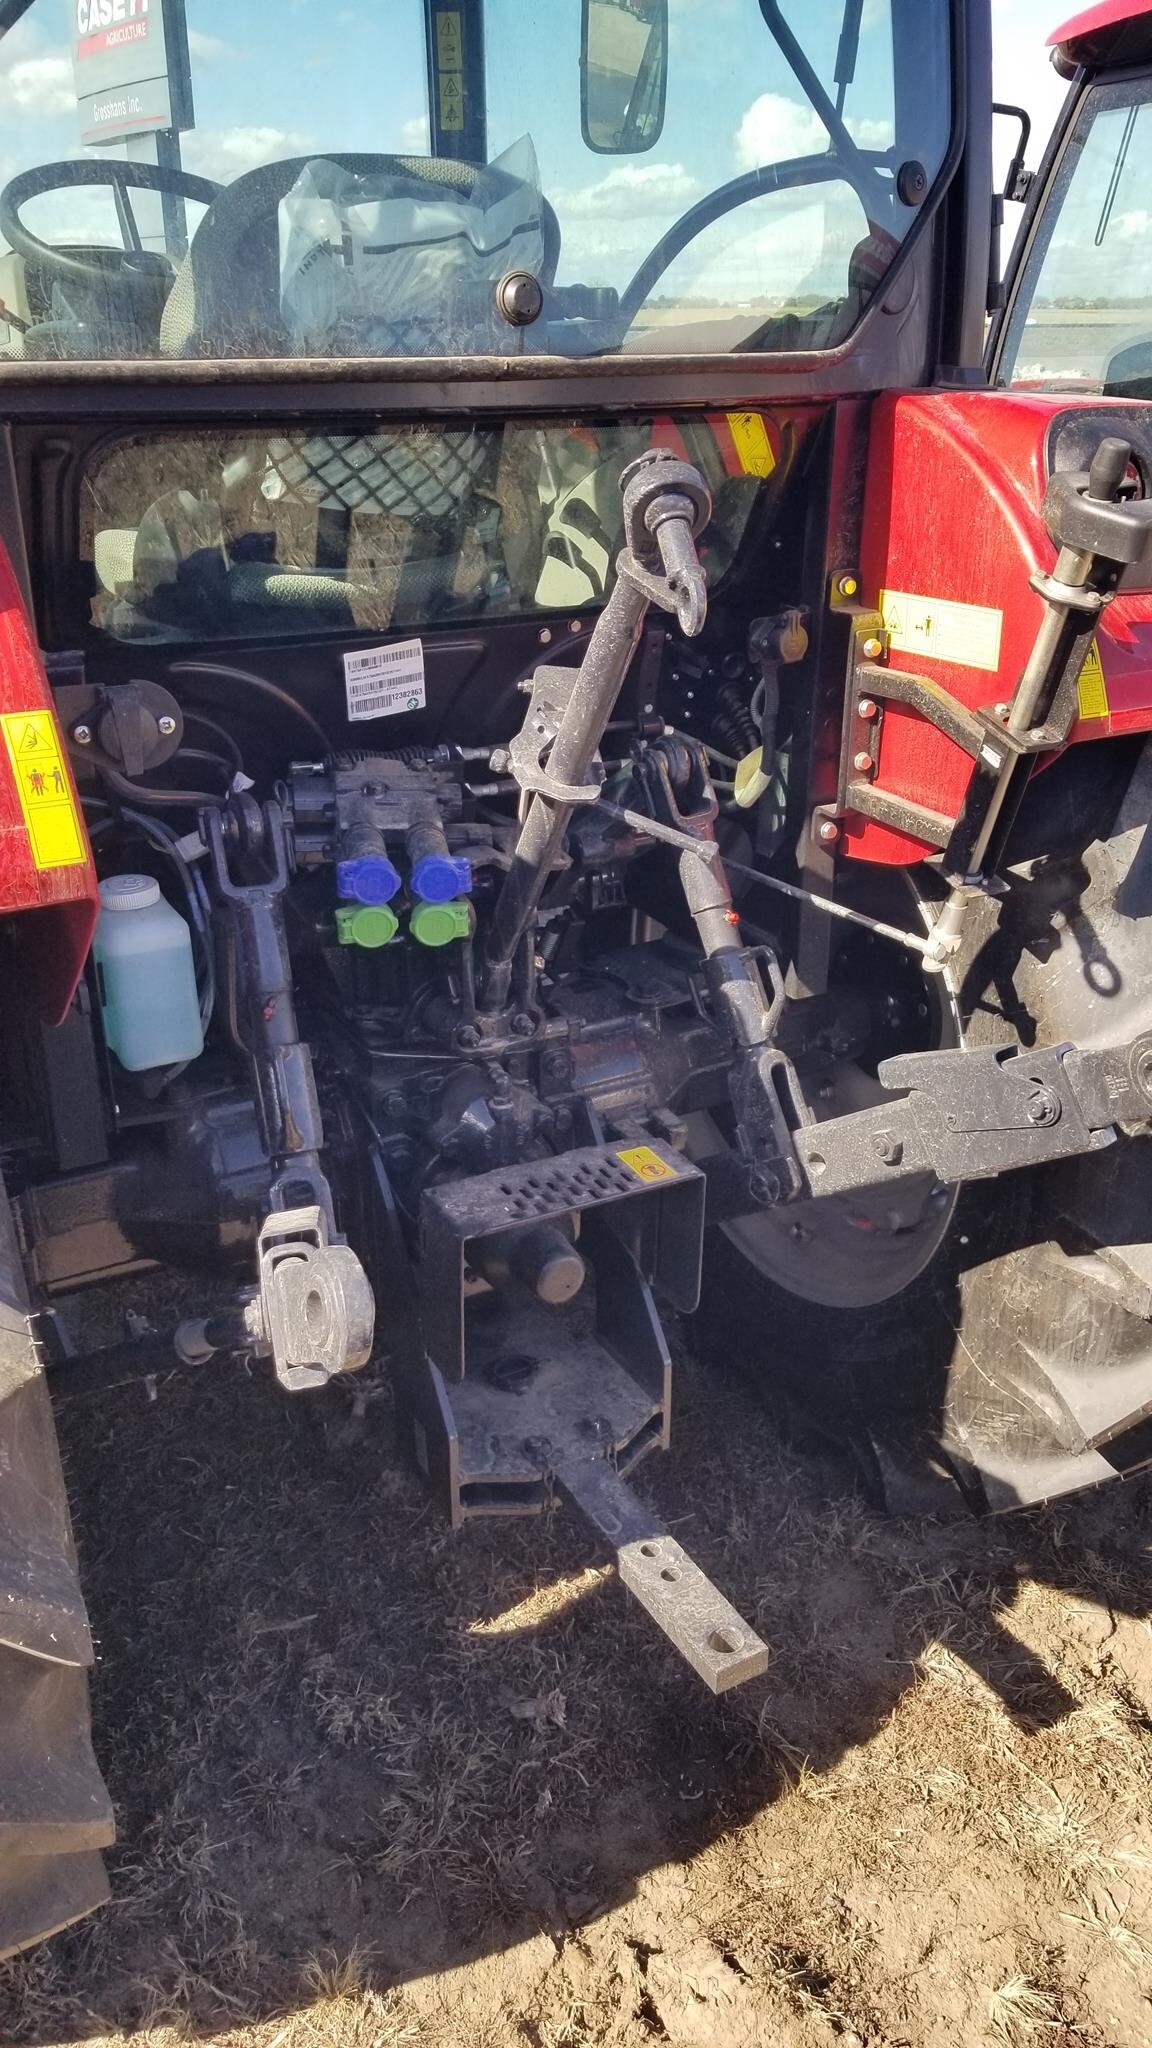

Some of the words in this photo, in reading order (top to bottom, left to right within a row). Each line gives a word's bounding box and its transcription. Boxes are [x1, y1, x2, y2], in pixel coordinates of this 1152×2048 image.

[77, 0, 126, 34] CASE
[105, 22, 147, 46] AGRICULTURE
[93, 100, 126, 121] Grosshans
